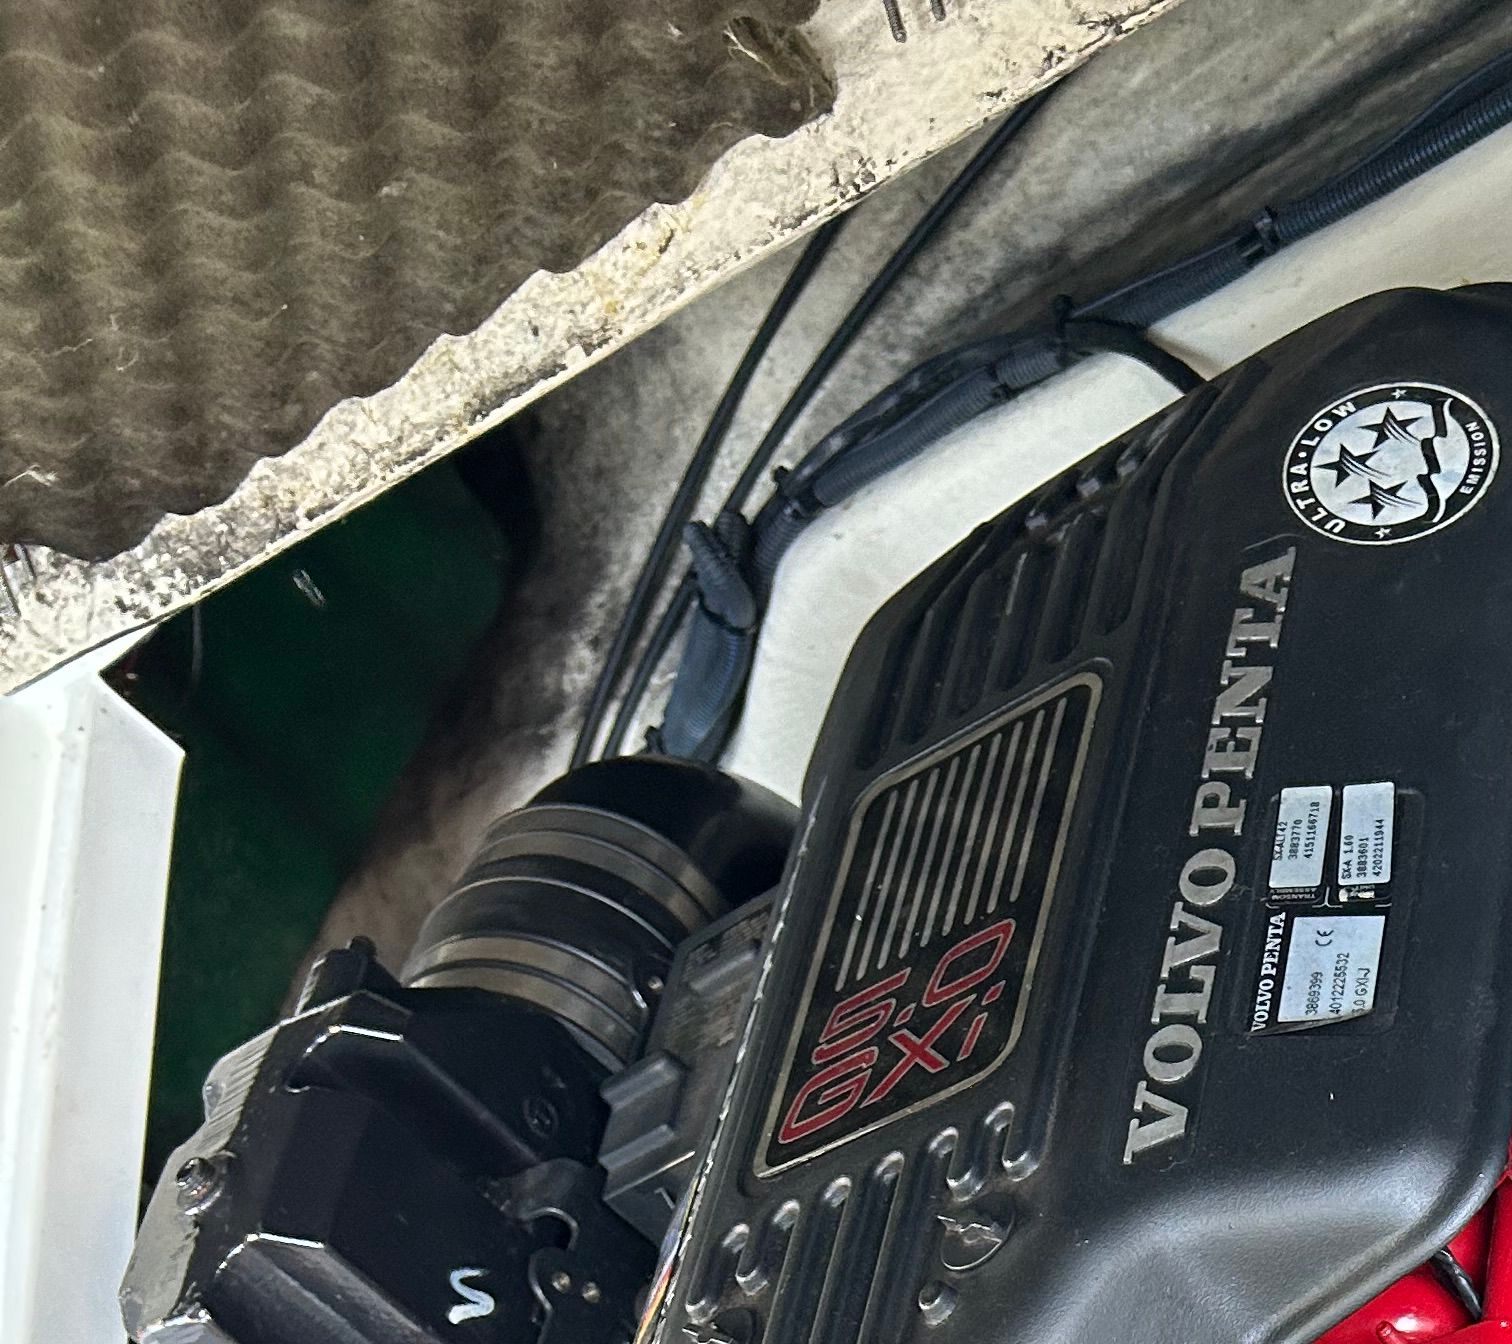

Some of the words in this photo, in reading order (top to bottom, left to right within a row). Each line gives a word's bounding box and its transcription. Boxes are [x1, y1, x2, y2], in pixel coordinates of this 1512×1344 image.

[1459, 421, 1487, 495] EMISSION
[1123, 848, 1236, 1164] VOLVO
[1189, 547, 1296, 837] PENTA
[1261, 912, 1286, 975] PENTA
[1252, 977, 1275, 1030] VOLVO
